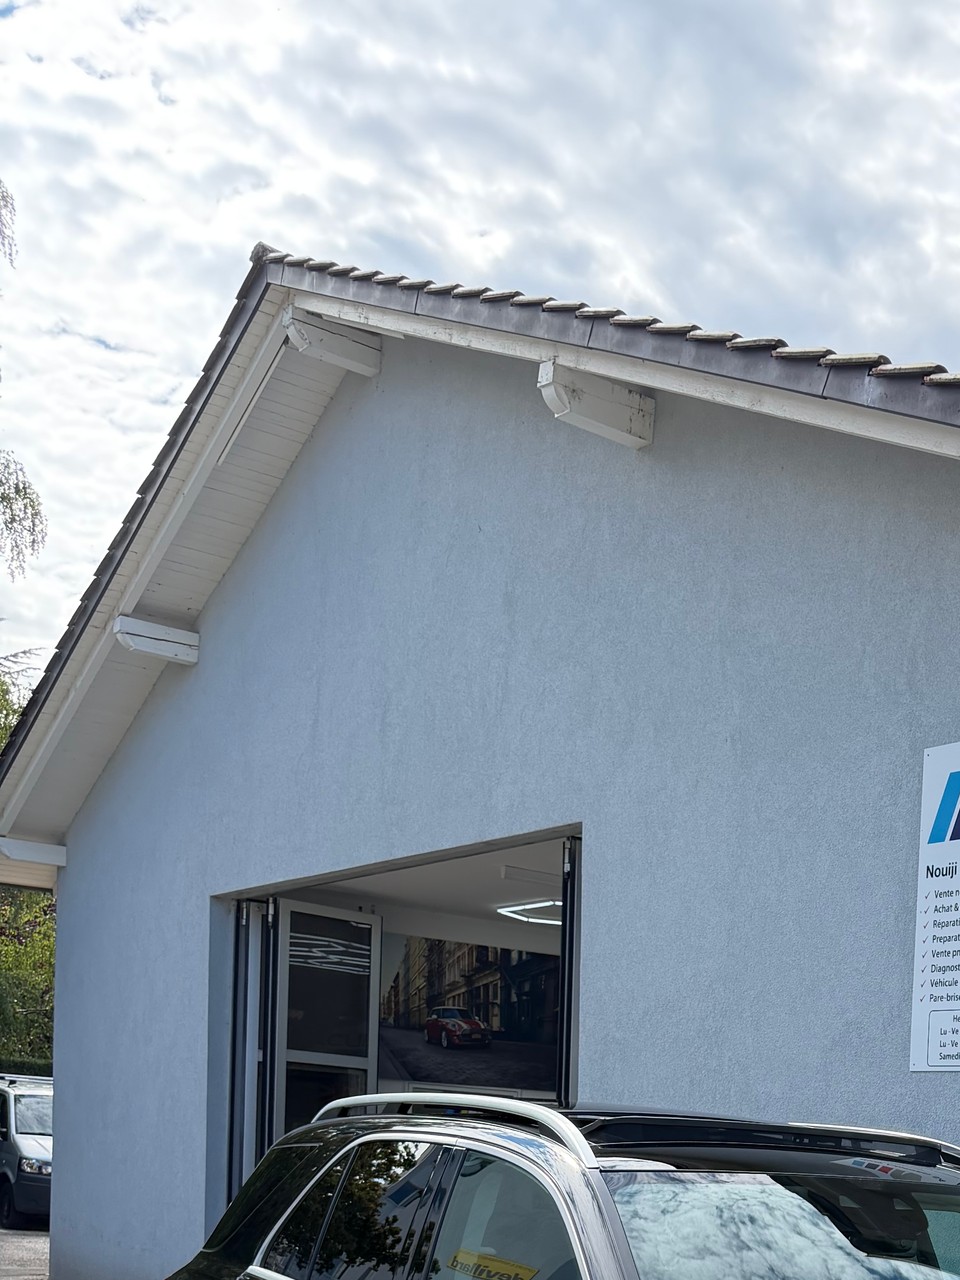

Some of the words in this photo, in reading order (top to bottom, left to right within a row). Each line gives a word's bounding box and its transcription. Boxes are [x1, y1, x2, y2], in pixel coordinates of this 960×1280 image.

[926, 862, 957, 879] Nouiji
[935, 890, 954, 899] Vente
[933, 904, 953, 913] Achat
[954, 902, 959, 912] &
[932, 949, 951, 959] Vente
[930, 978, 959, 988] Véhicule
[940, 1028, 947, 1036] Lu
[952, 1027, 959, 1035] Ve
[939, 1052, 960, 1060] Samedi
